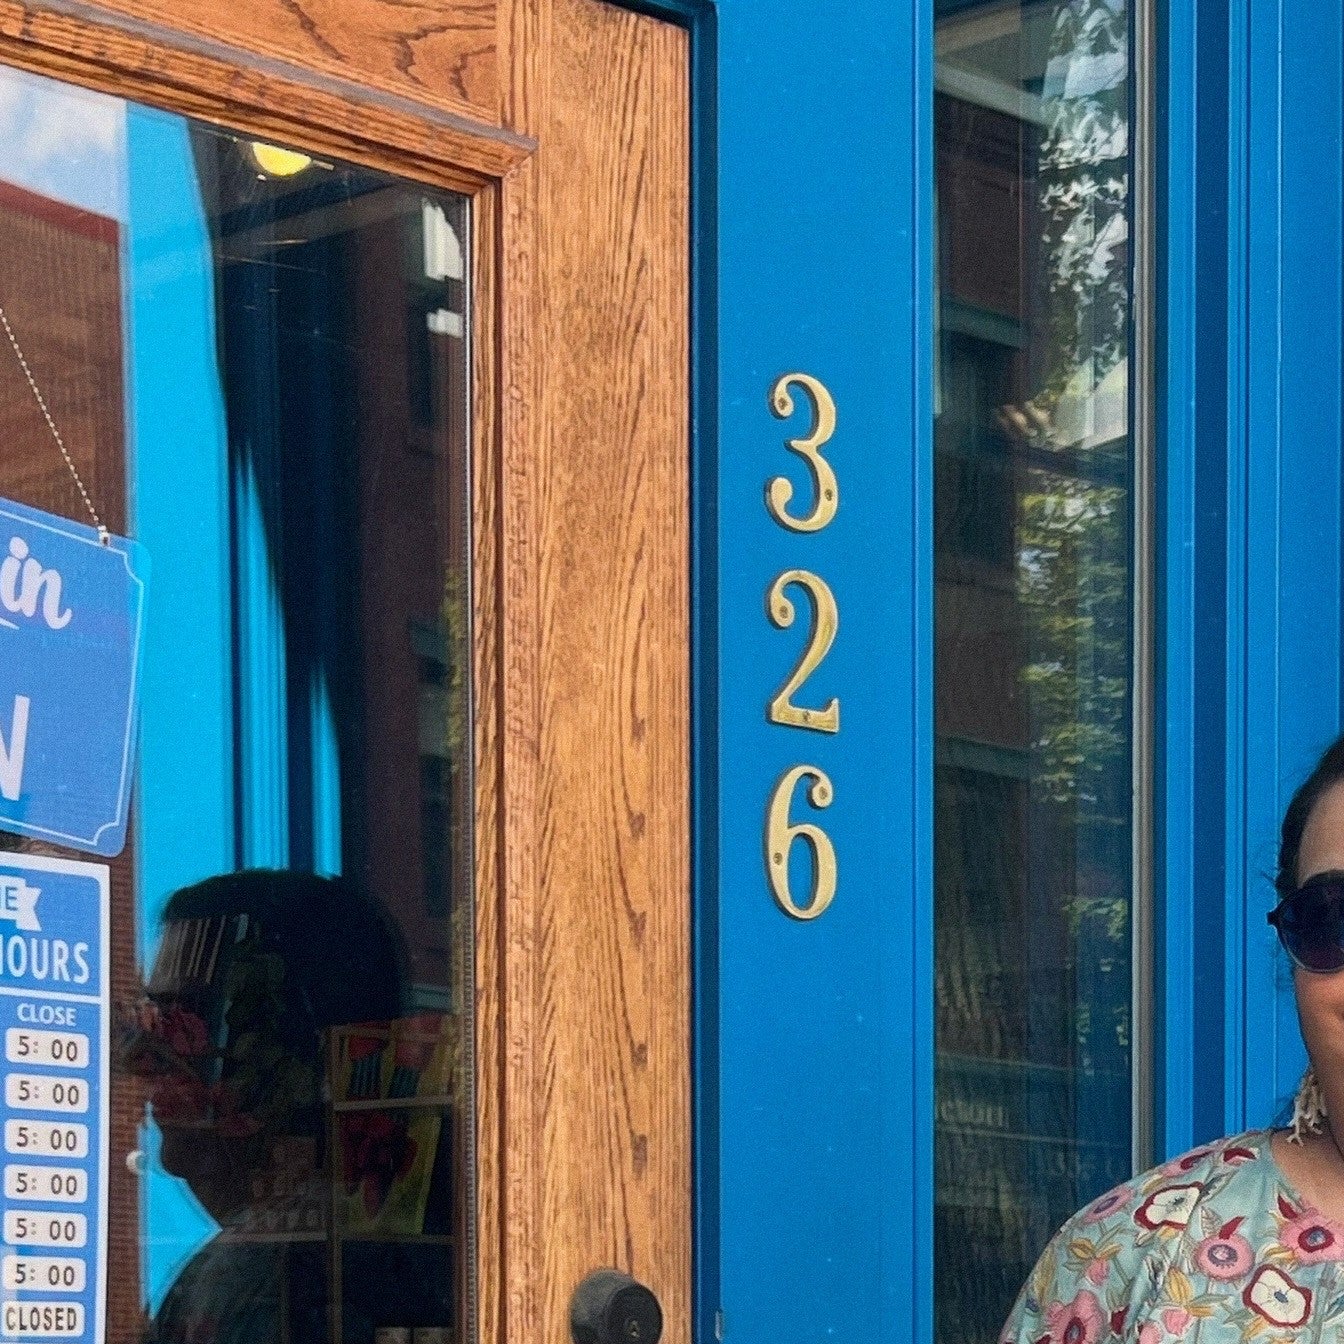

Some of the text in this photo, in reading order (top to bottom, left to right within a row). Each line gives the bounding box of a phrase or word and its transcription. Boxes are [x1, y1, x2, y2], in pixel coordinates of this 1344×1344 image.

[0, 934, 90, 984] OURS
[17, 1003, 77, 1027] CLOSE
[6, 1306, 77, 1331] CLOSED
